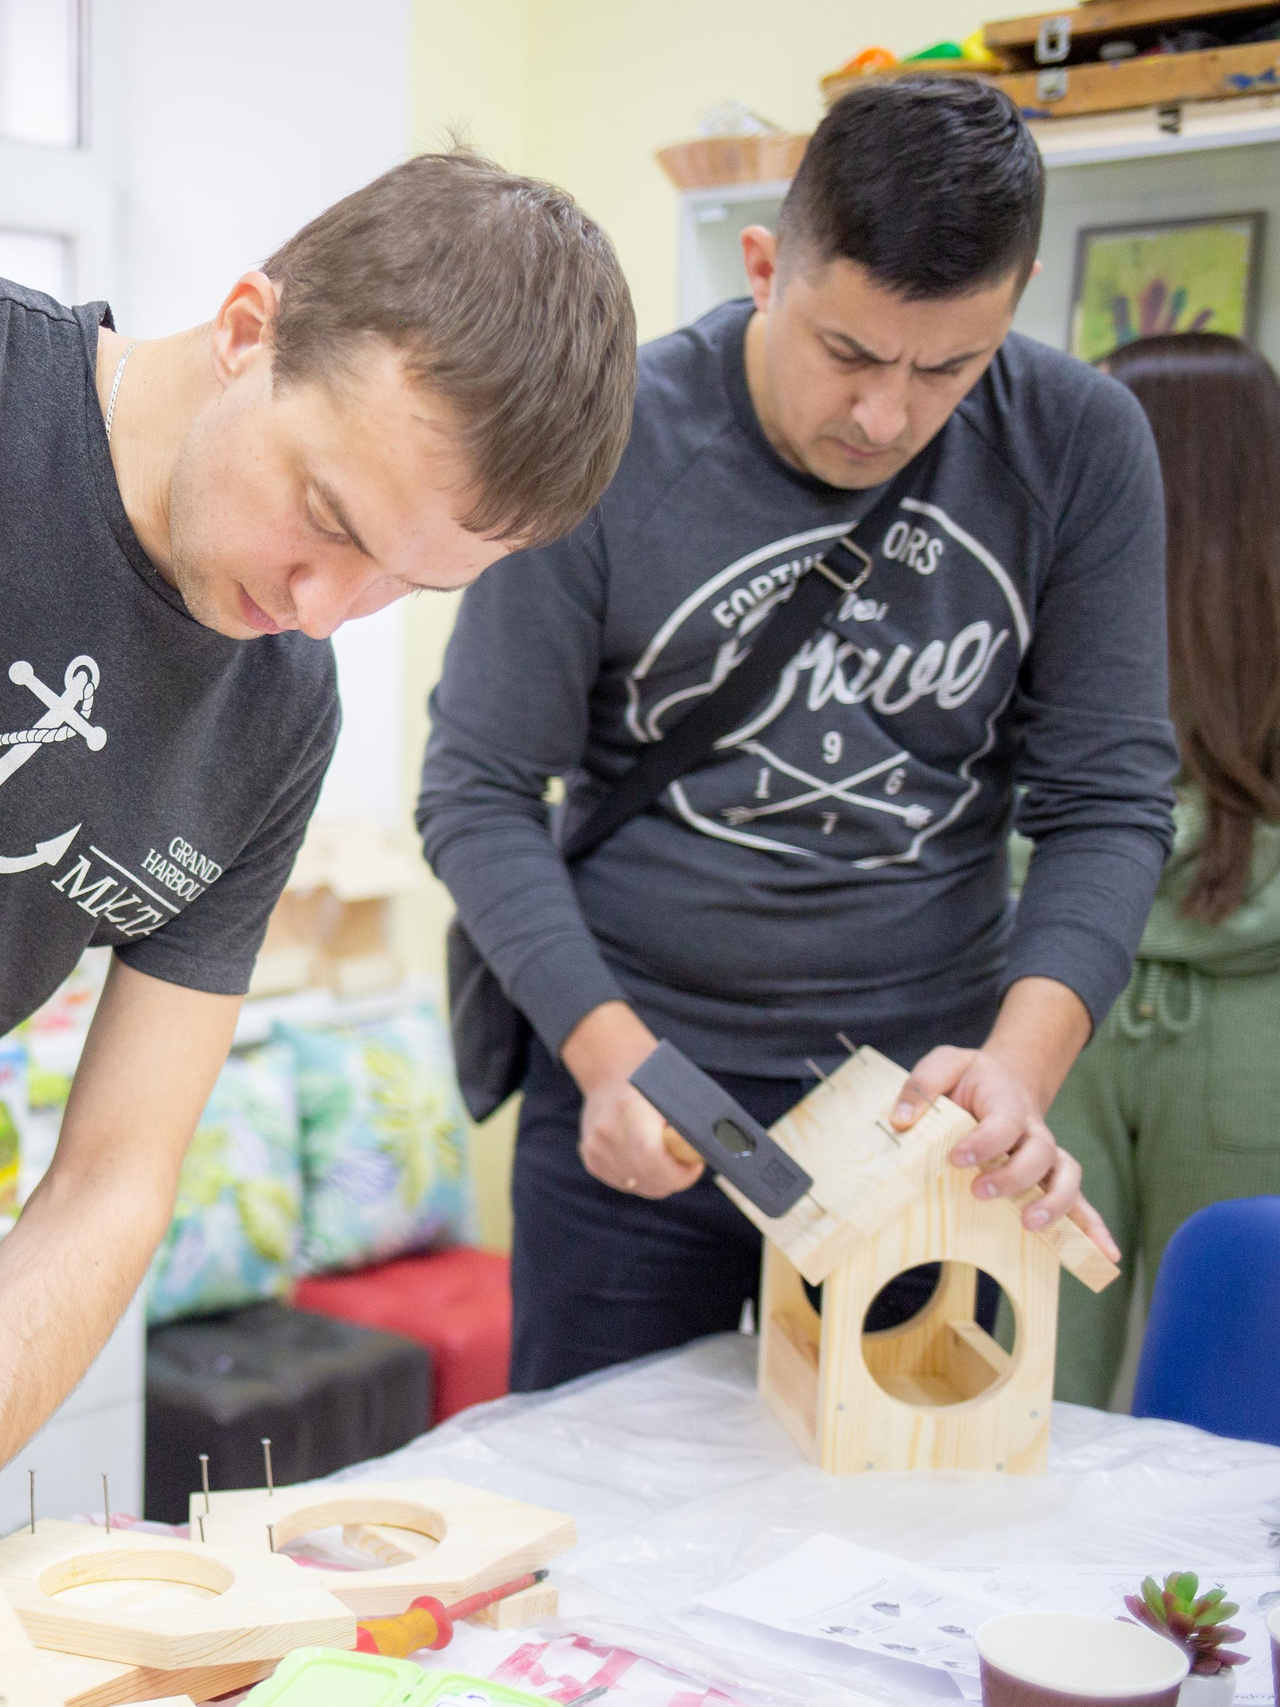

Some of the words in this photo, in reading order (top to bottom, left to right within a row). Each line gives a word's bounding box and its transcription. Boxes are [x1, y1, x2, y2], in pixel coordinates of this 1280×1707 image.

[823, 731, 843, 764] 9
[755, 767, 770, 799] 1
[884, 768, 906, 795] 6
[168, 836, 223, 884] GRAND
